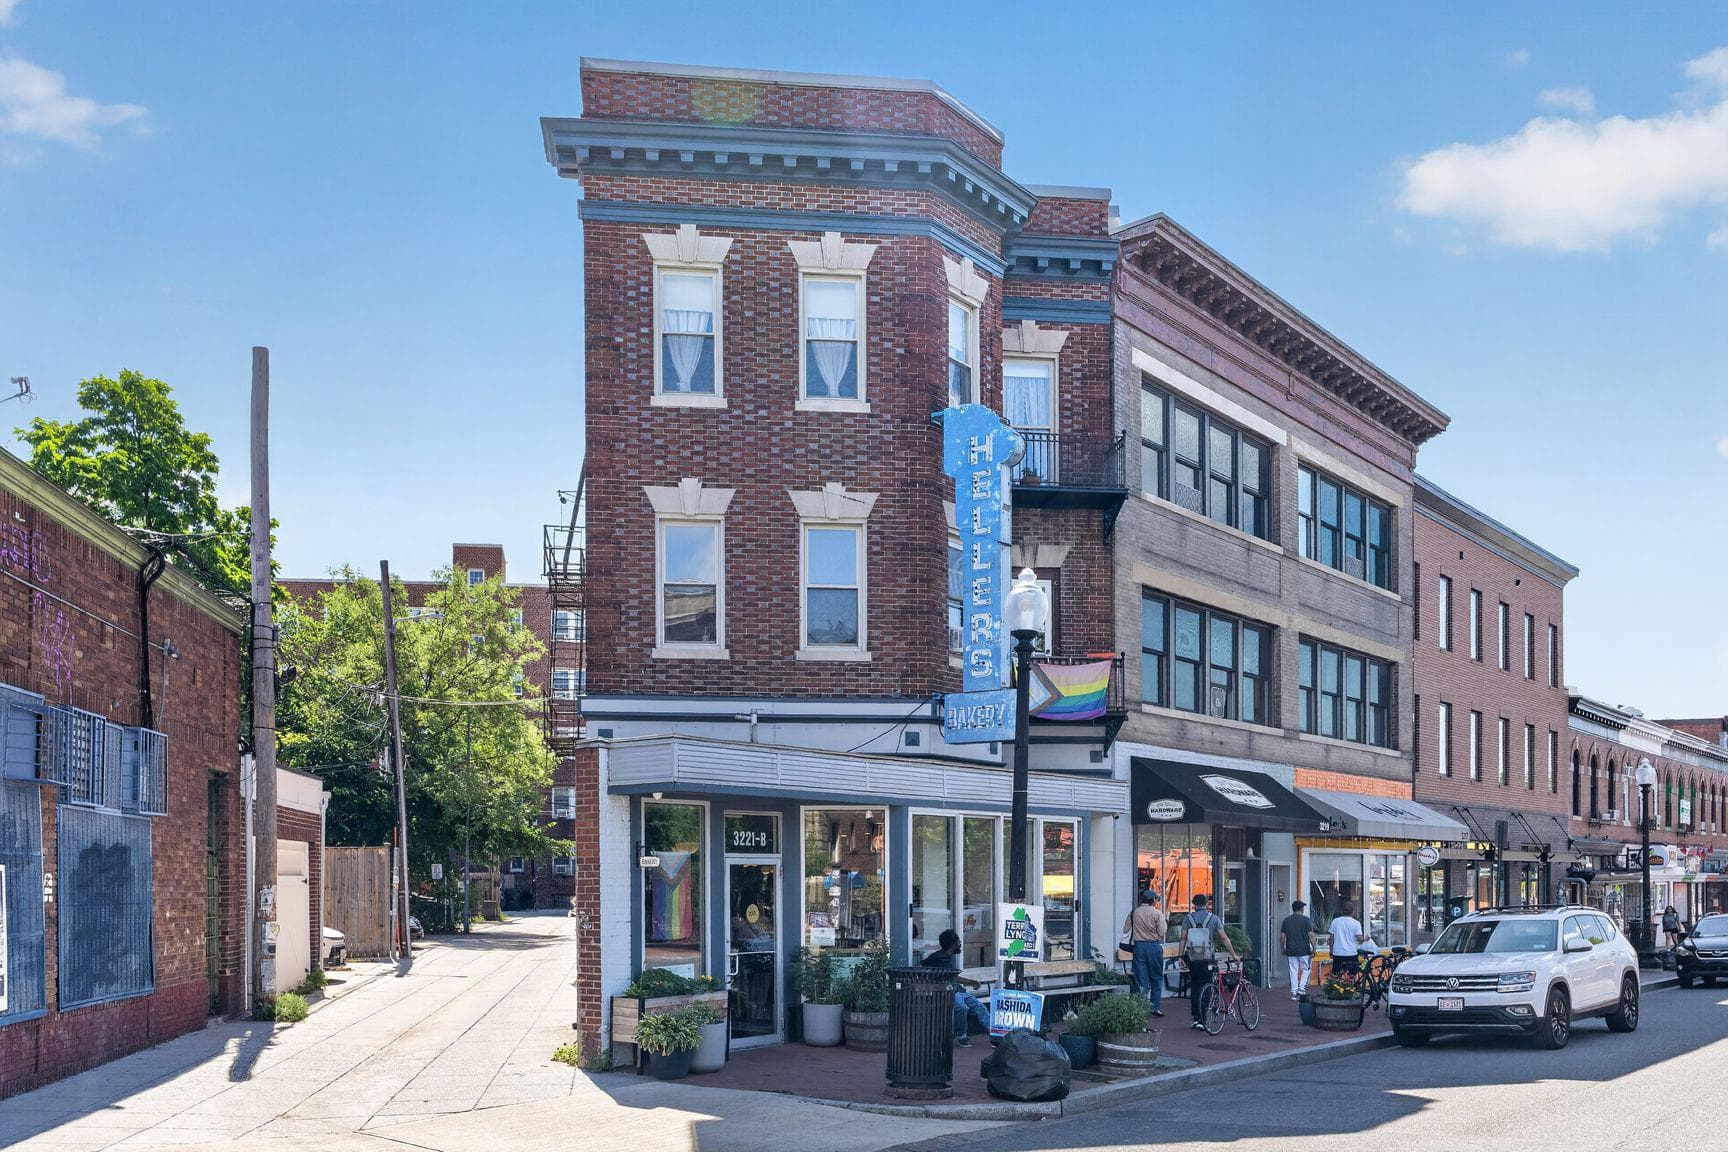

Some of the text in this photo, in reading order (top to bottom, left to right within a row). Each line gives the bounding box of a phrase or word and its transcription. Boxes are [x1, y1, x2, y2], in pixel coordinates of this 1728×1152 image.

[969, 433, 994, 679] HELLERS
[947, 703, 1007, 730] BAKERY
[1319, 821, 1330, 831] 3219
[733, 831, 767, 847] 3221-B
[1453, 906, 1461, 917] P
[996, 1000, 1033, 1014] RASHIDA
[994, 1011, 1036, 1031] BROWN
